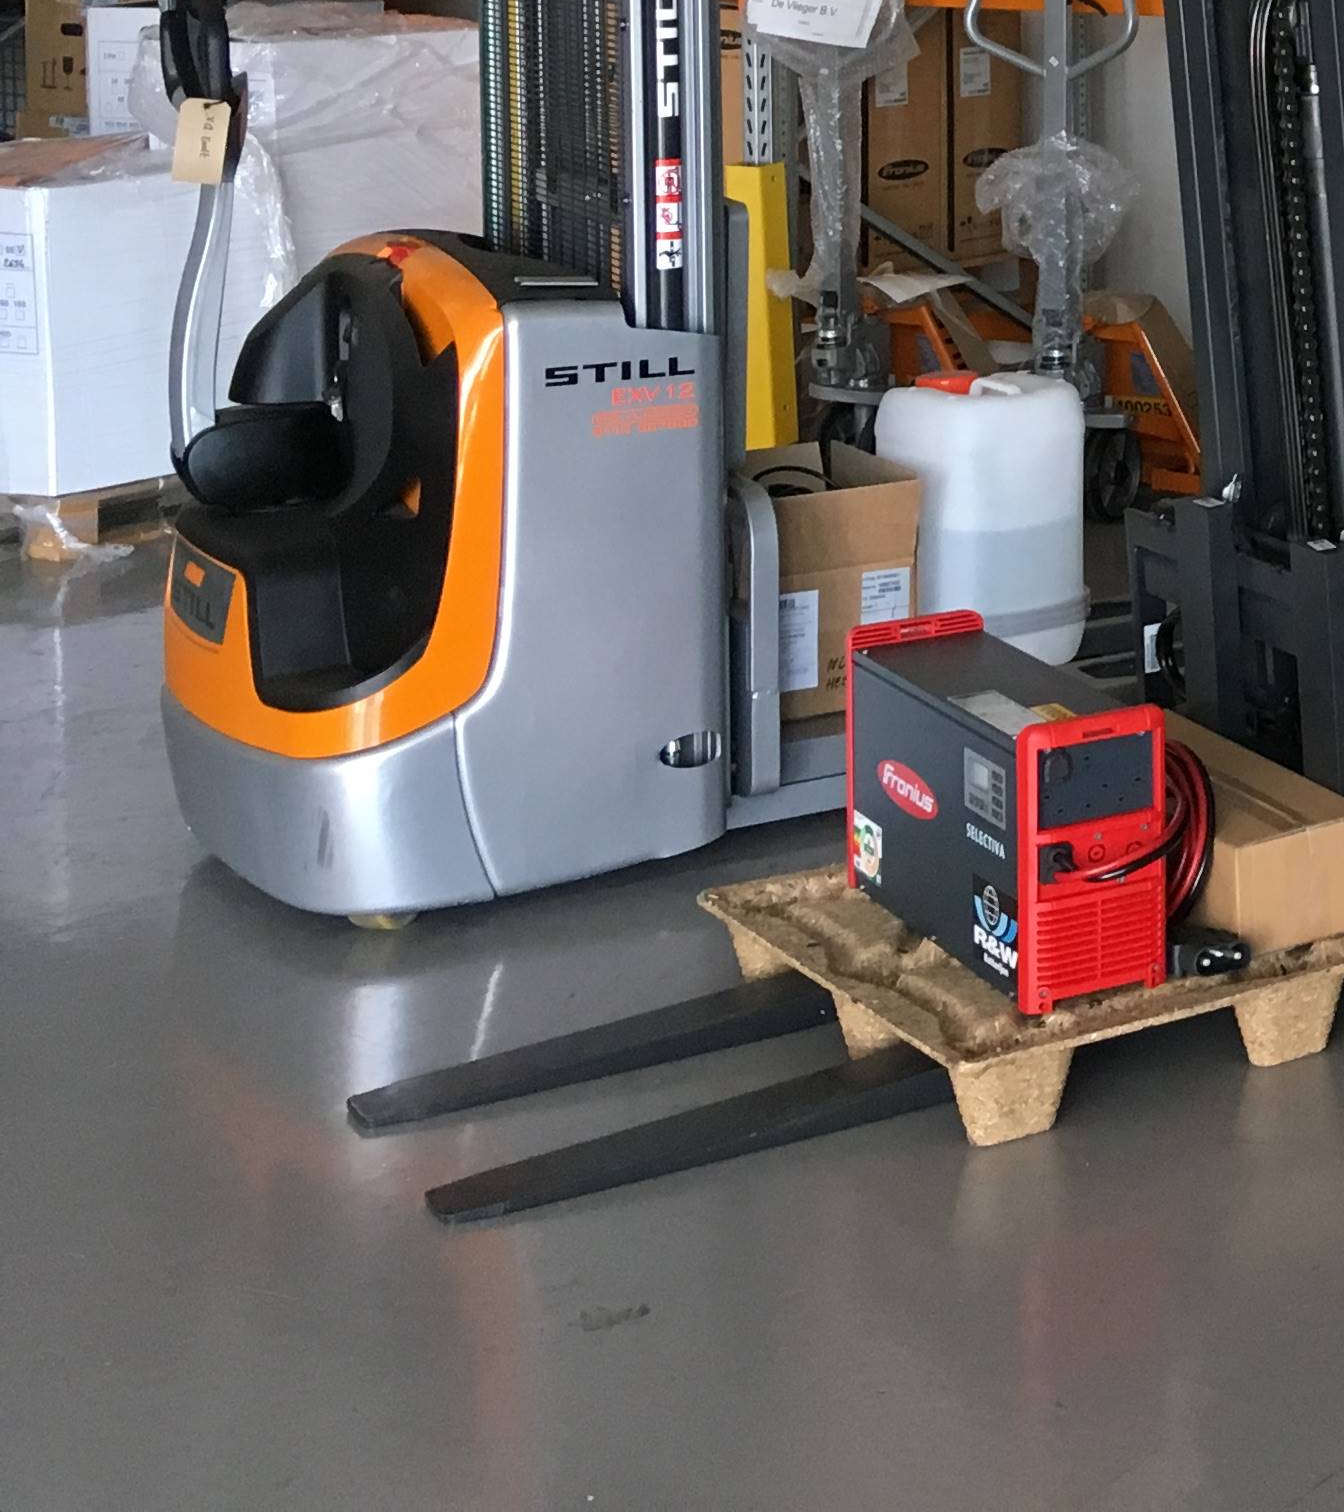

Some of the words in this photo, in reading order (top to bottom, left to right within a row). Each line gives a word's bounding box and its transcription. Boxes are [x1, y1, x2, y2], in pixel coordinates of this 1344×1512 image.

[545, 356, 695, 387] STILL
[611, 384, 662, 406] EXV
[965, 822, 1006, 860] SELECTIVA
[973, 923, 1019, 970] R&W
